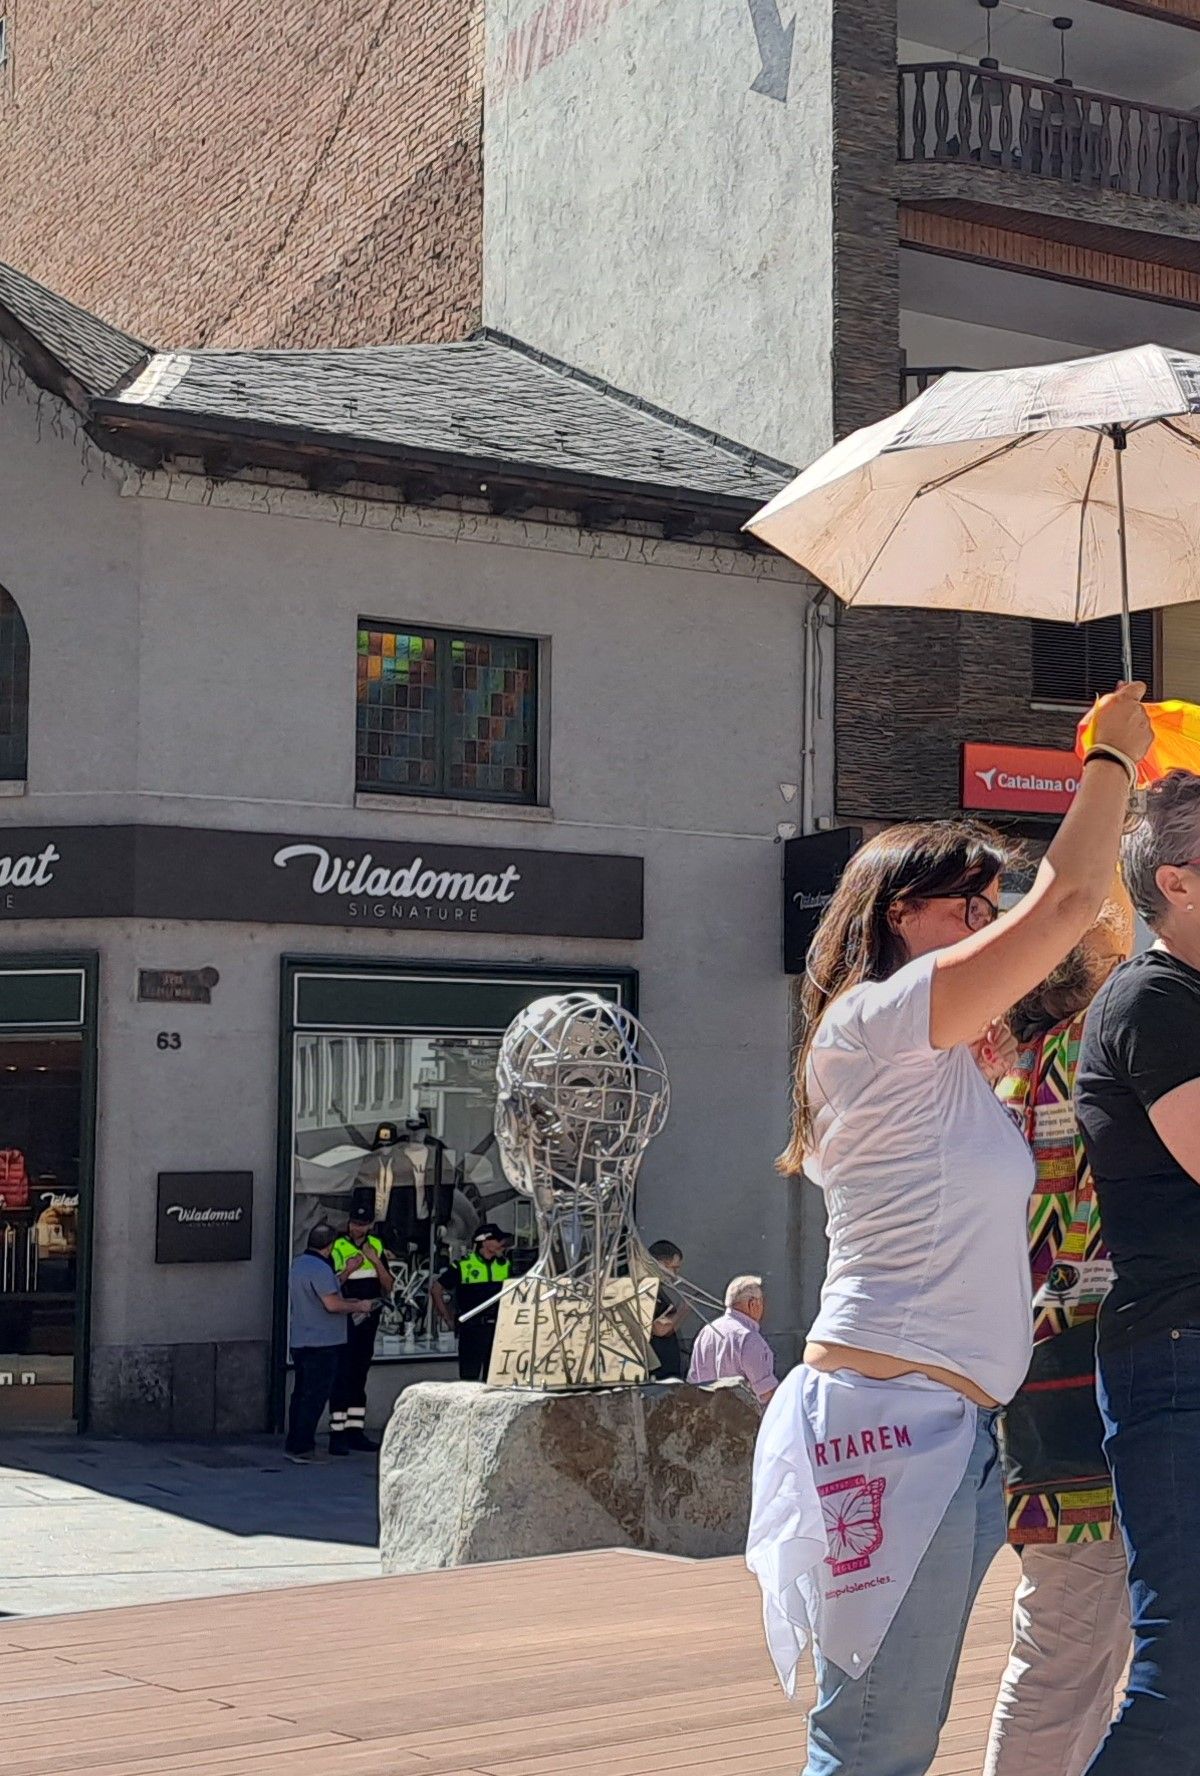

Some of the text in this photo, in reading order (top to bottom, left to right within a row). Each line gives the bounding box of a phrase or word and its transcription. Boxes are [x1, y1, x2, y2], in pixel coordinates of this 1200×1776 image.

[998, 773, 1062, 791] Catalana
[273, 844, 521, 903] Viladomat
[349, 902, 479, 922] SIGNATURE
[157, 1031, 182, 1050] 63
[166, 1206, 242, 1222] Viladomat
[815, 1425, 912, 1467] RTAREM
